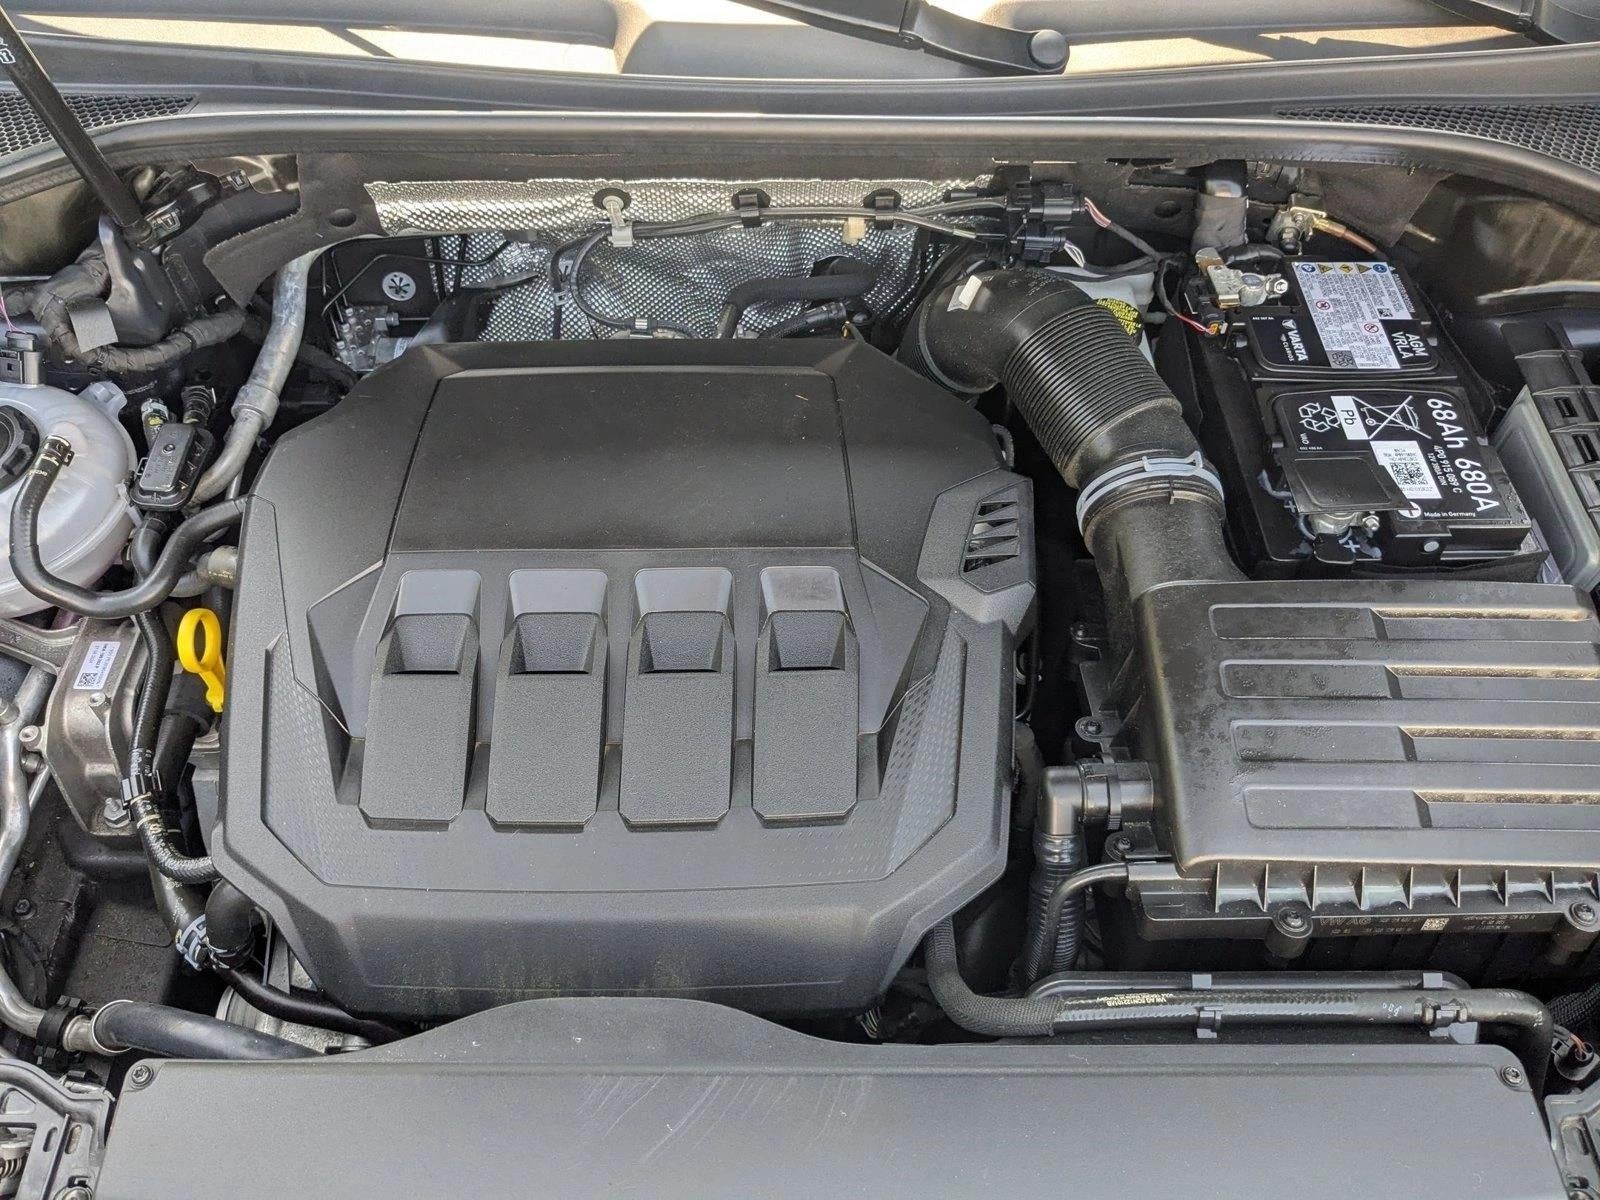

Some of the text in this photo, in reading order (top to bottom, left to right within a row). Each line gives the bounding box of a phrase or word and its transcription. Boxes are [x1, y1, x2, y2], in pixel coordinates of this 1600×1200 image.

[1287, 329, 1309, 361] VARTA
[1391, 331, 1414, 359] VRLA
[1405, 333, 1429, 356] AGM
[1340, 409, 1357, 426] Pb
[1426, 398, 1500, 512] 68Ah 680A
